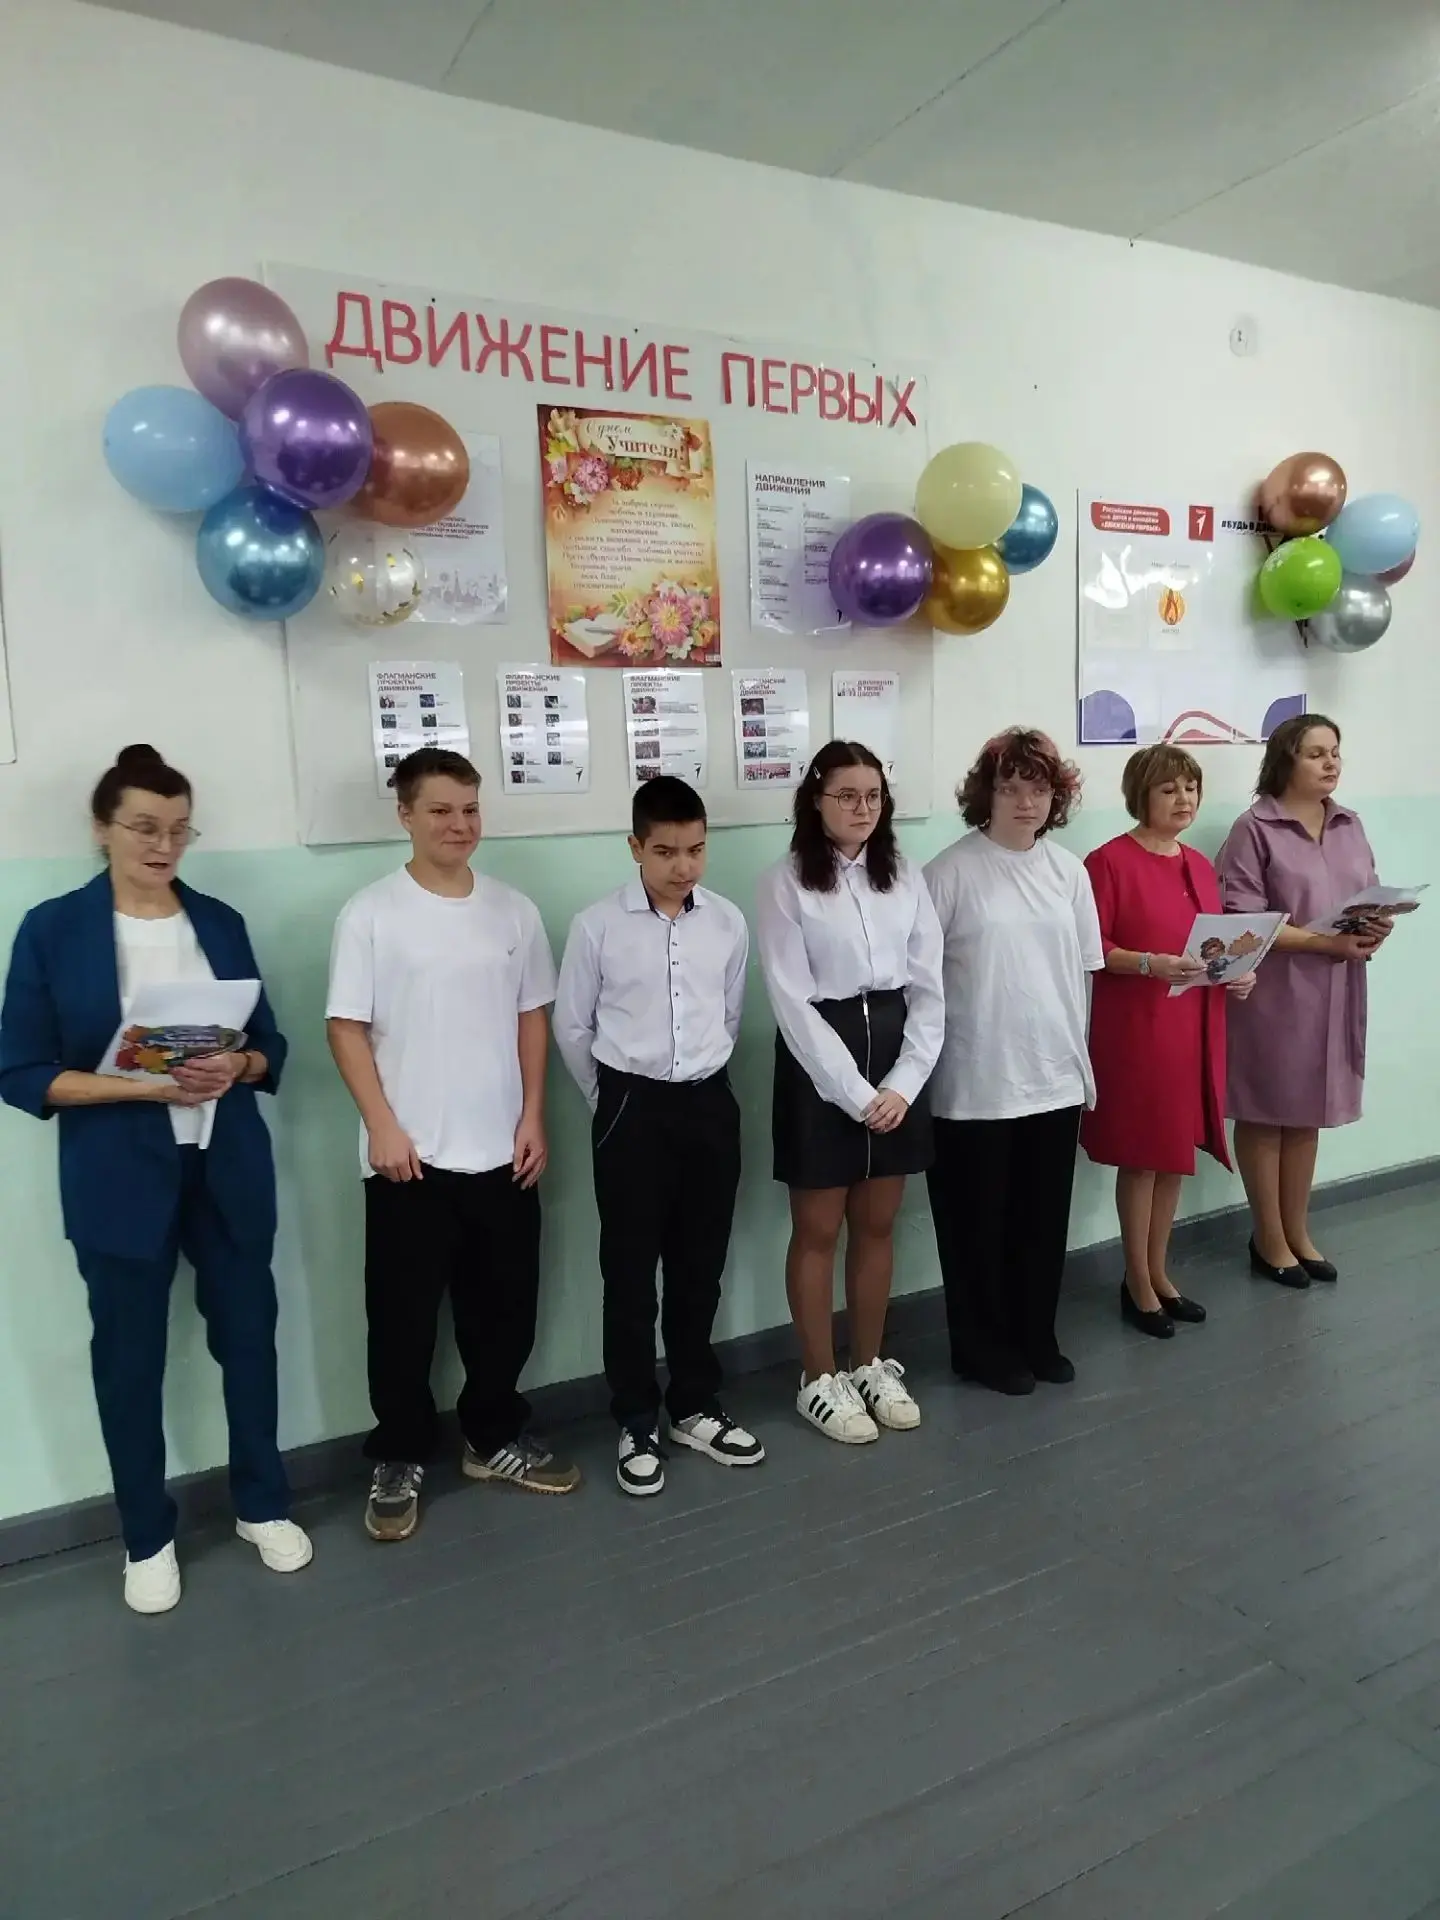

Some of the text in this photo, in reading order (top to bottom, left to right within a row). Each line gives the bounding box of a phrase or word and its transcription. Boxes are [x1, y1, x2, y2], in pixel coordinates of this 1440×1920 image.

[325, 291, 917, 428] ДВИЖЕНИЕ ПЕРВЫХ
[755, 473, 826, 489] НАПРАВЛЕНИЯ
[755, 482, 811, 496] ДВИЖЕНИЯ
